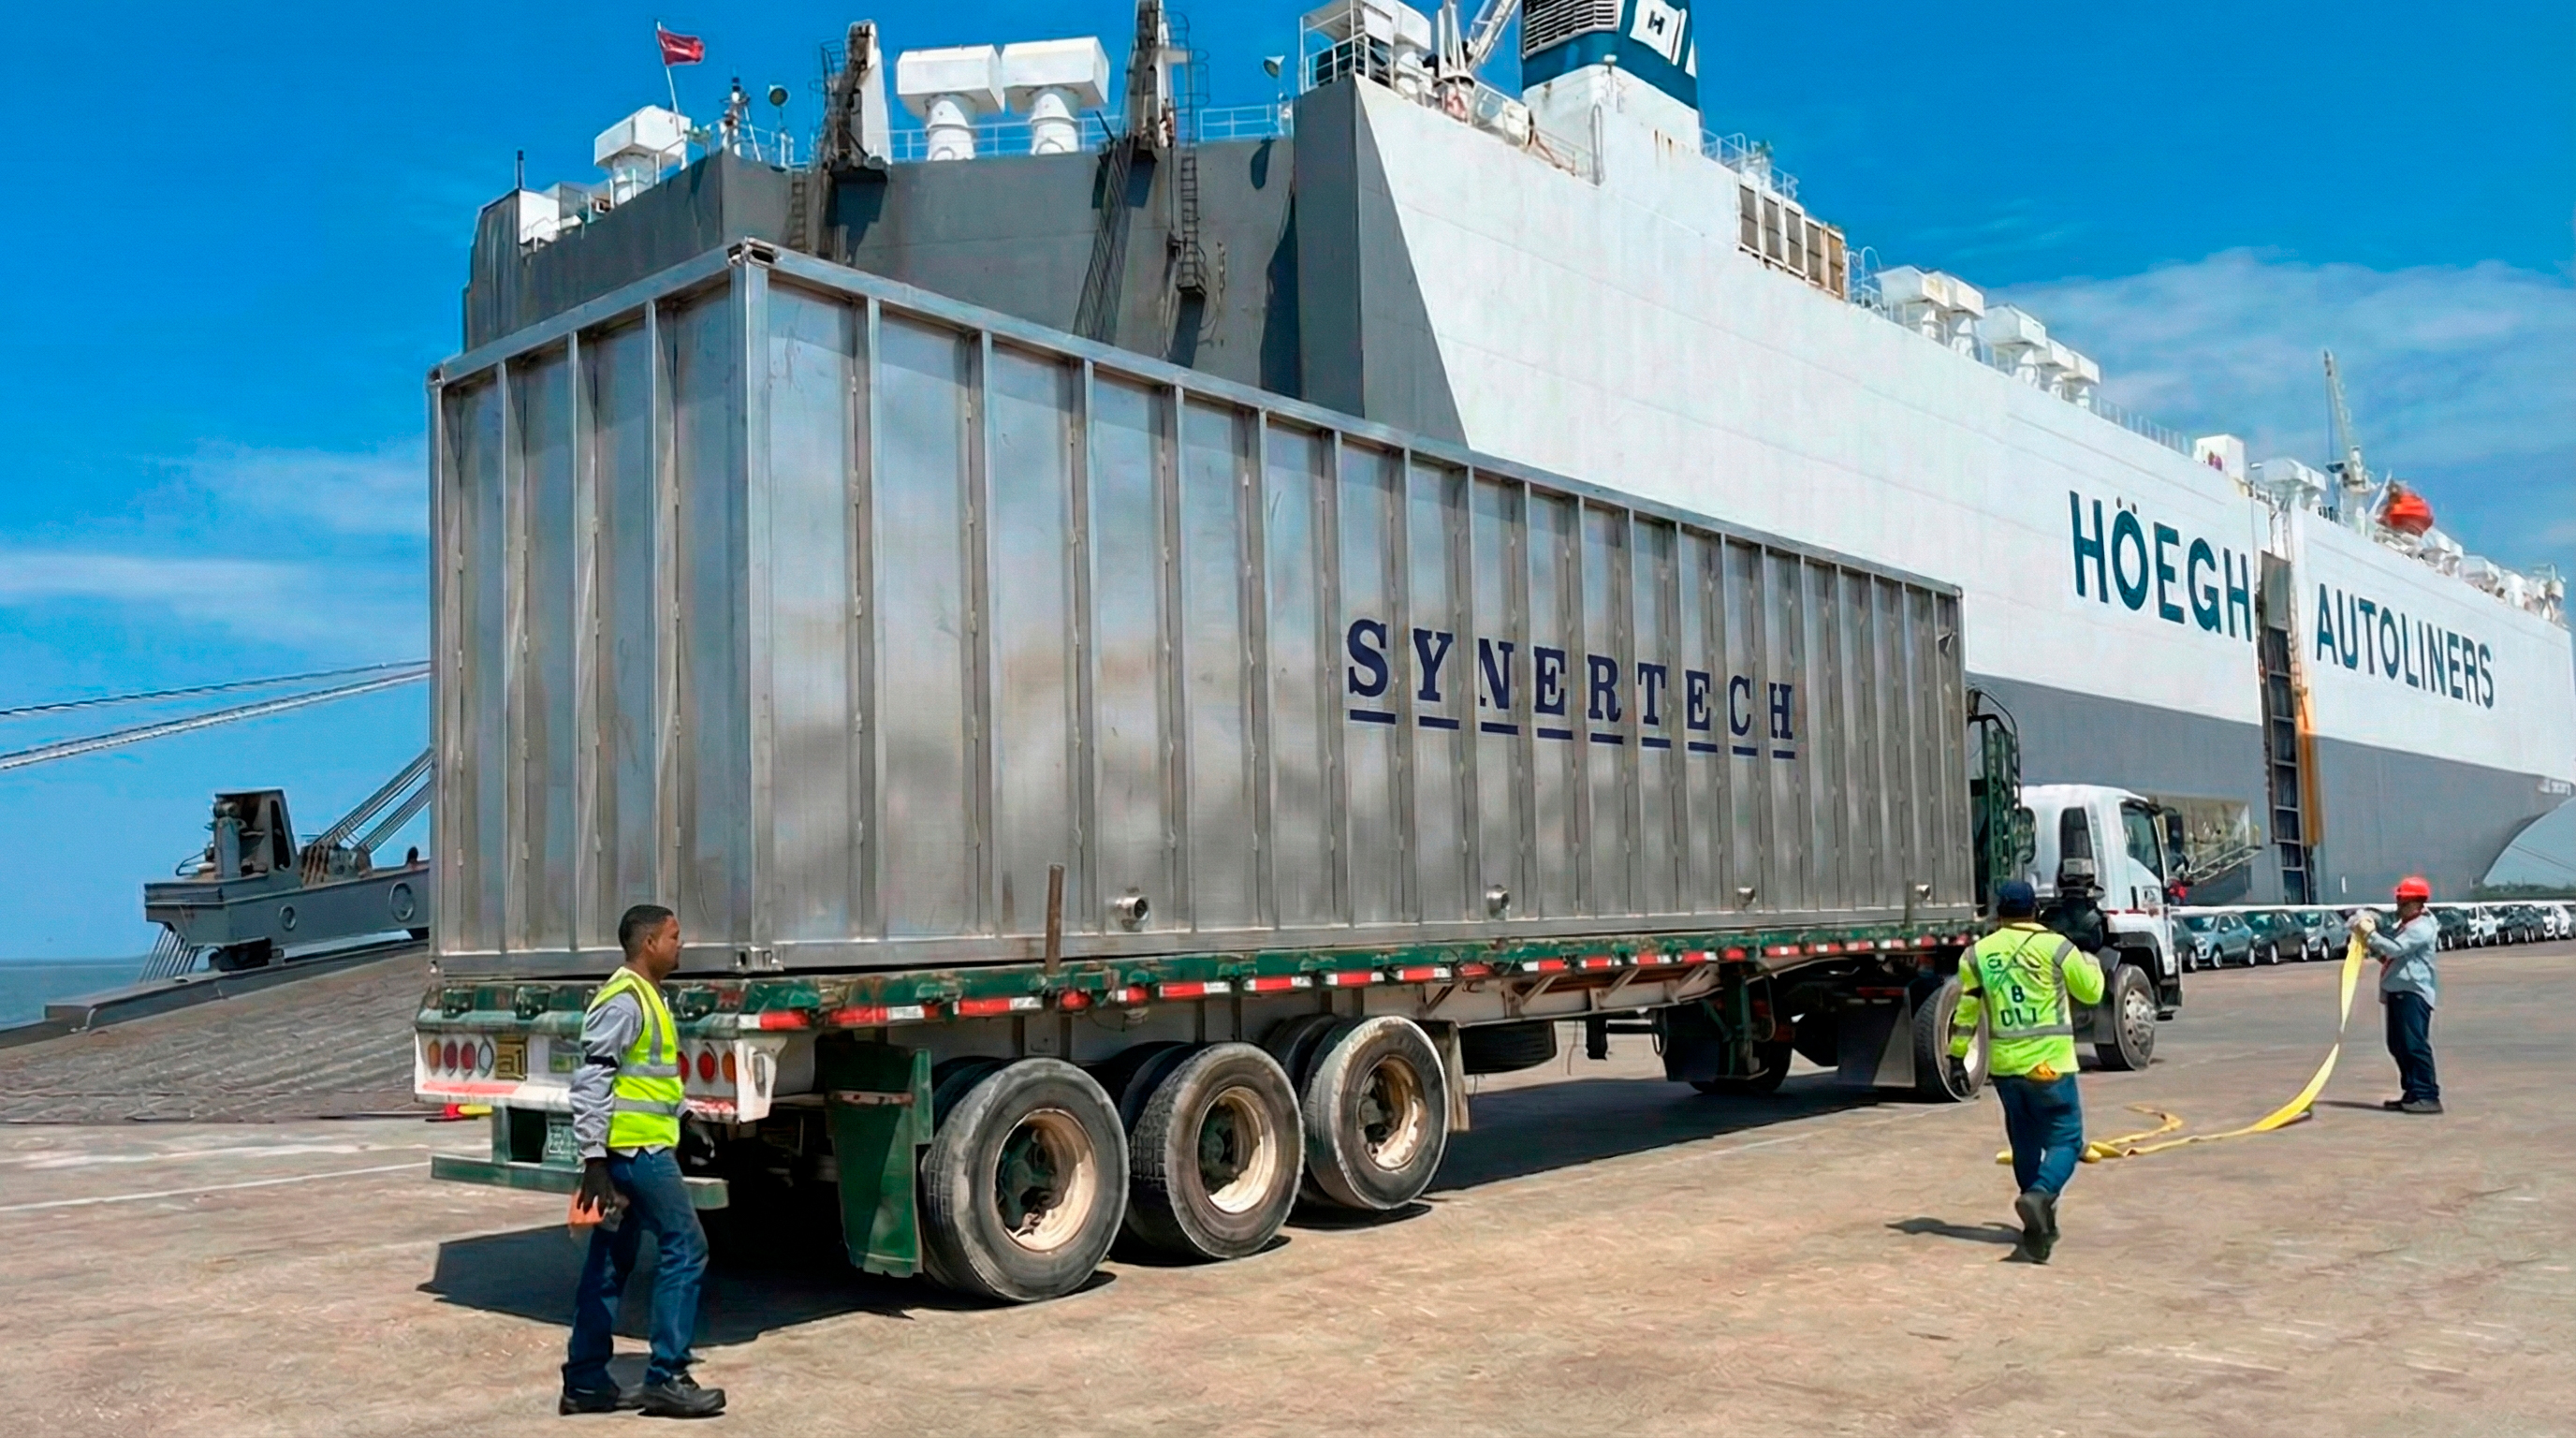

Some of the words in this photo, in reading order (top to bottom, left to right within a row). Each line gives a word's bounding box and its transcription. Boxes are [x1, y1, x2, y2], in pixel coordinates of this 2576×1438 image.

[1647, 10, 1665, 36] H
[2070, 491, 2253, 642] HÖEGH
[2316, 582, 2496, 710] AUTOLINERS
[1347, 618, 1794, 741] SYNERTECH
